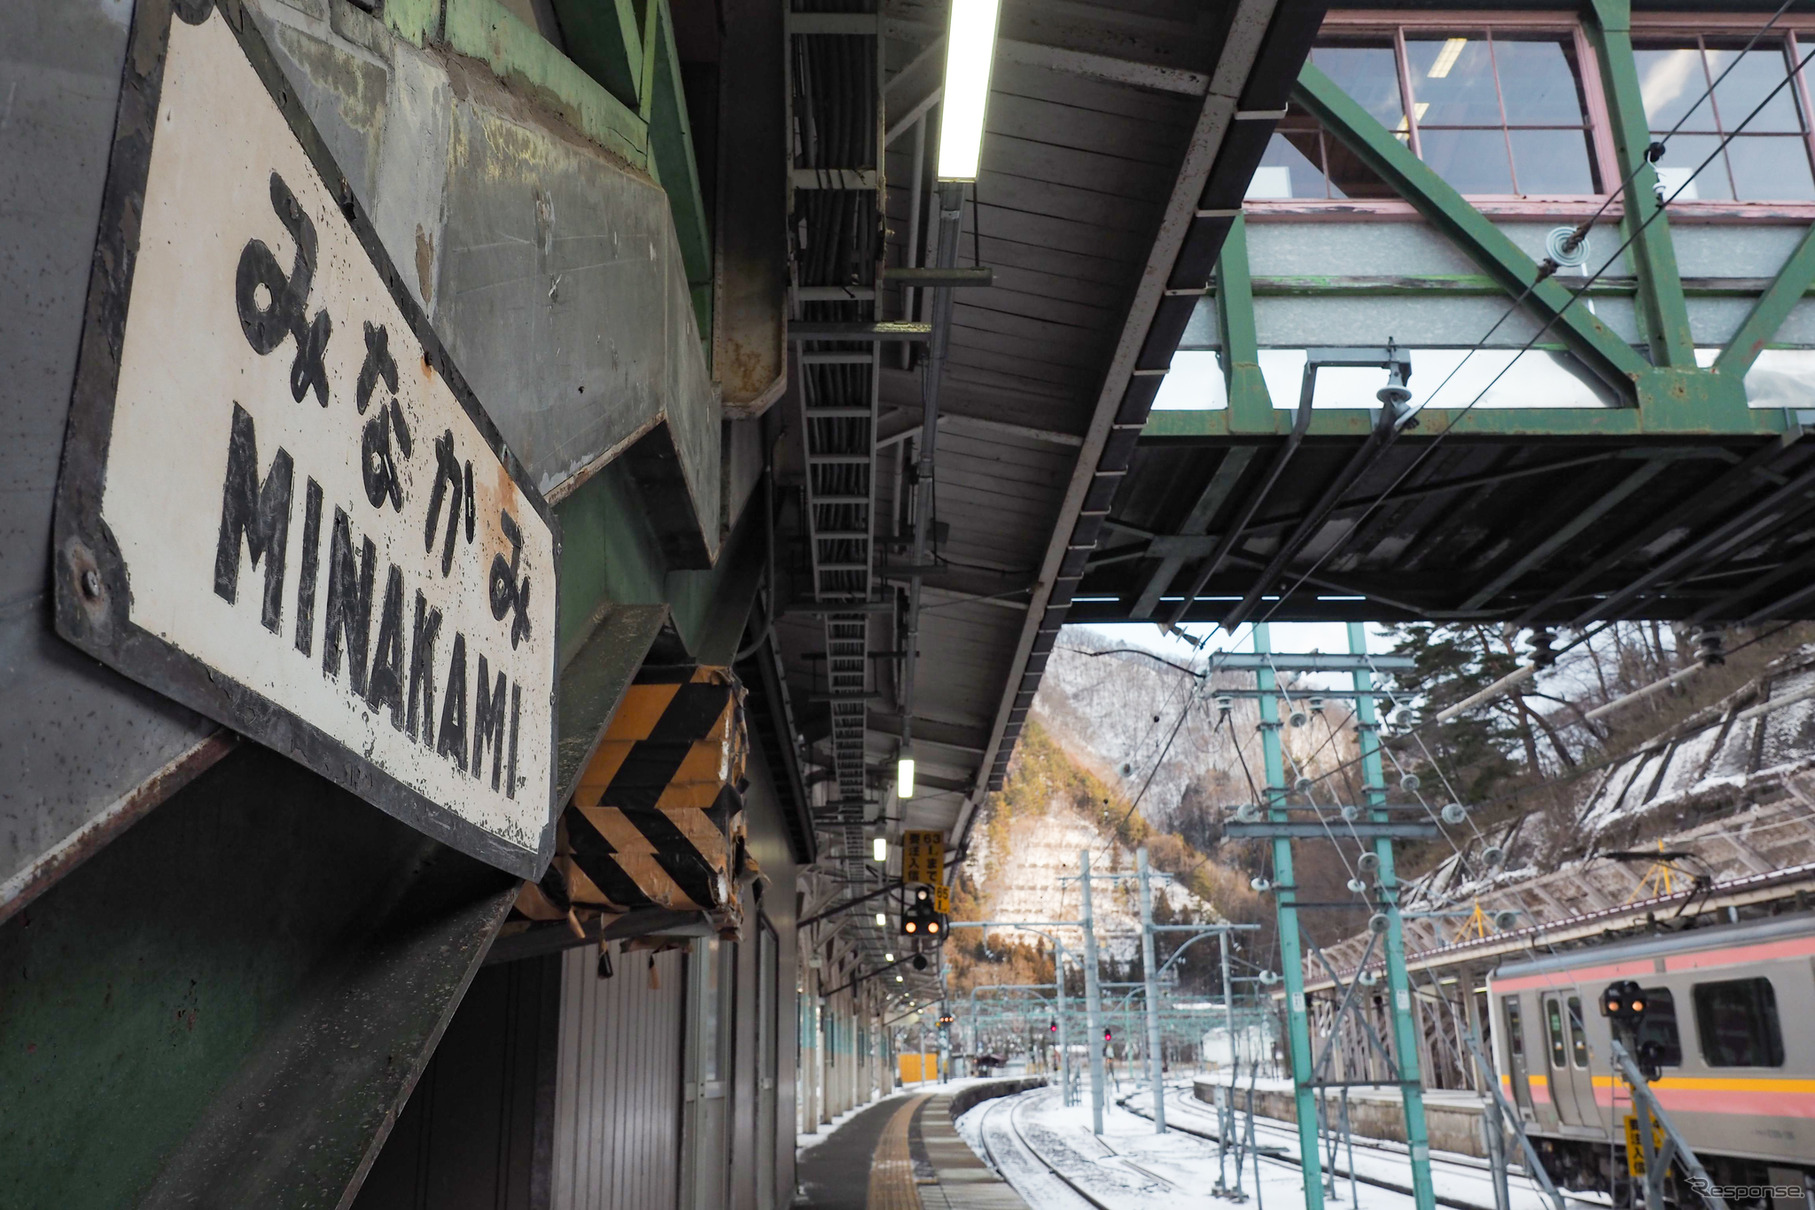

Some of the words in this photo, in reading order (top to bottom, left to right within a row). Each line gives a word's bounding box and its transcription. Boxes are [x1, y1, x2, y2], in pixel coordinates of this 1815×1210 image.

[213, 400, 522, 800] MINAKAMI
[235, 168, 531, 650] みなかみ
